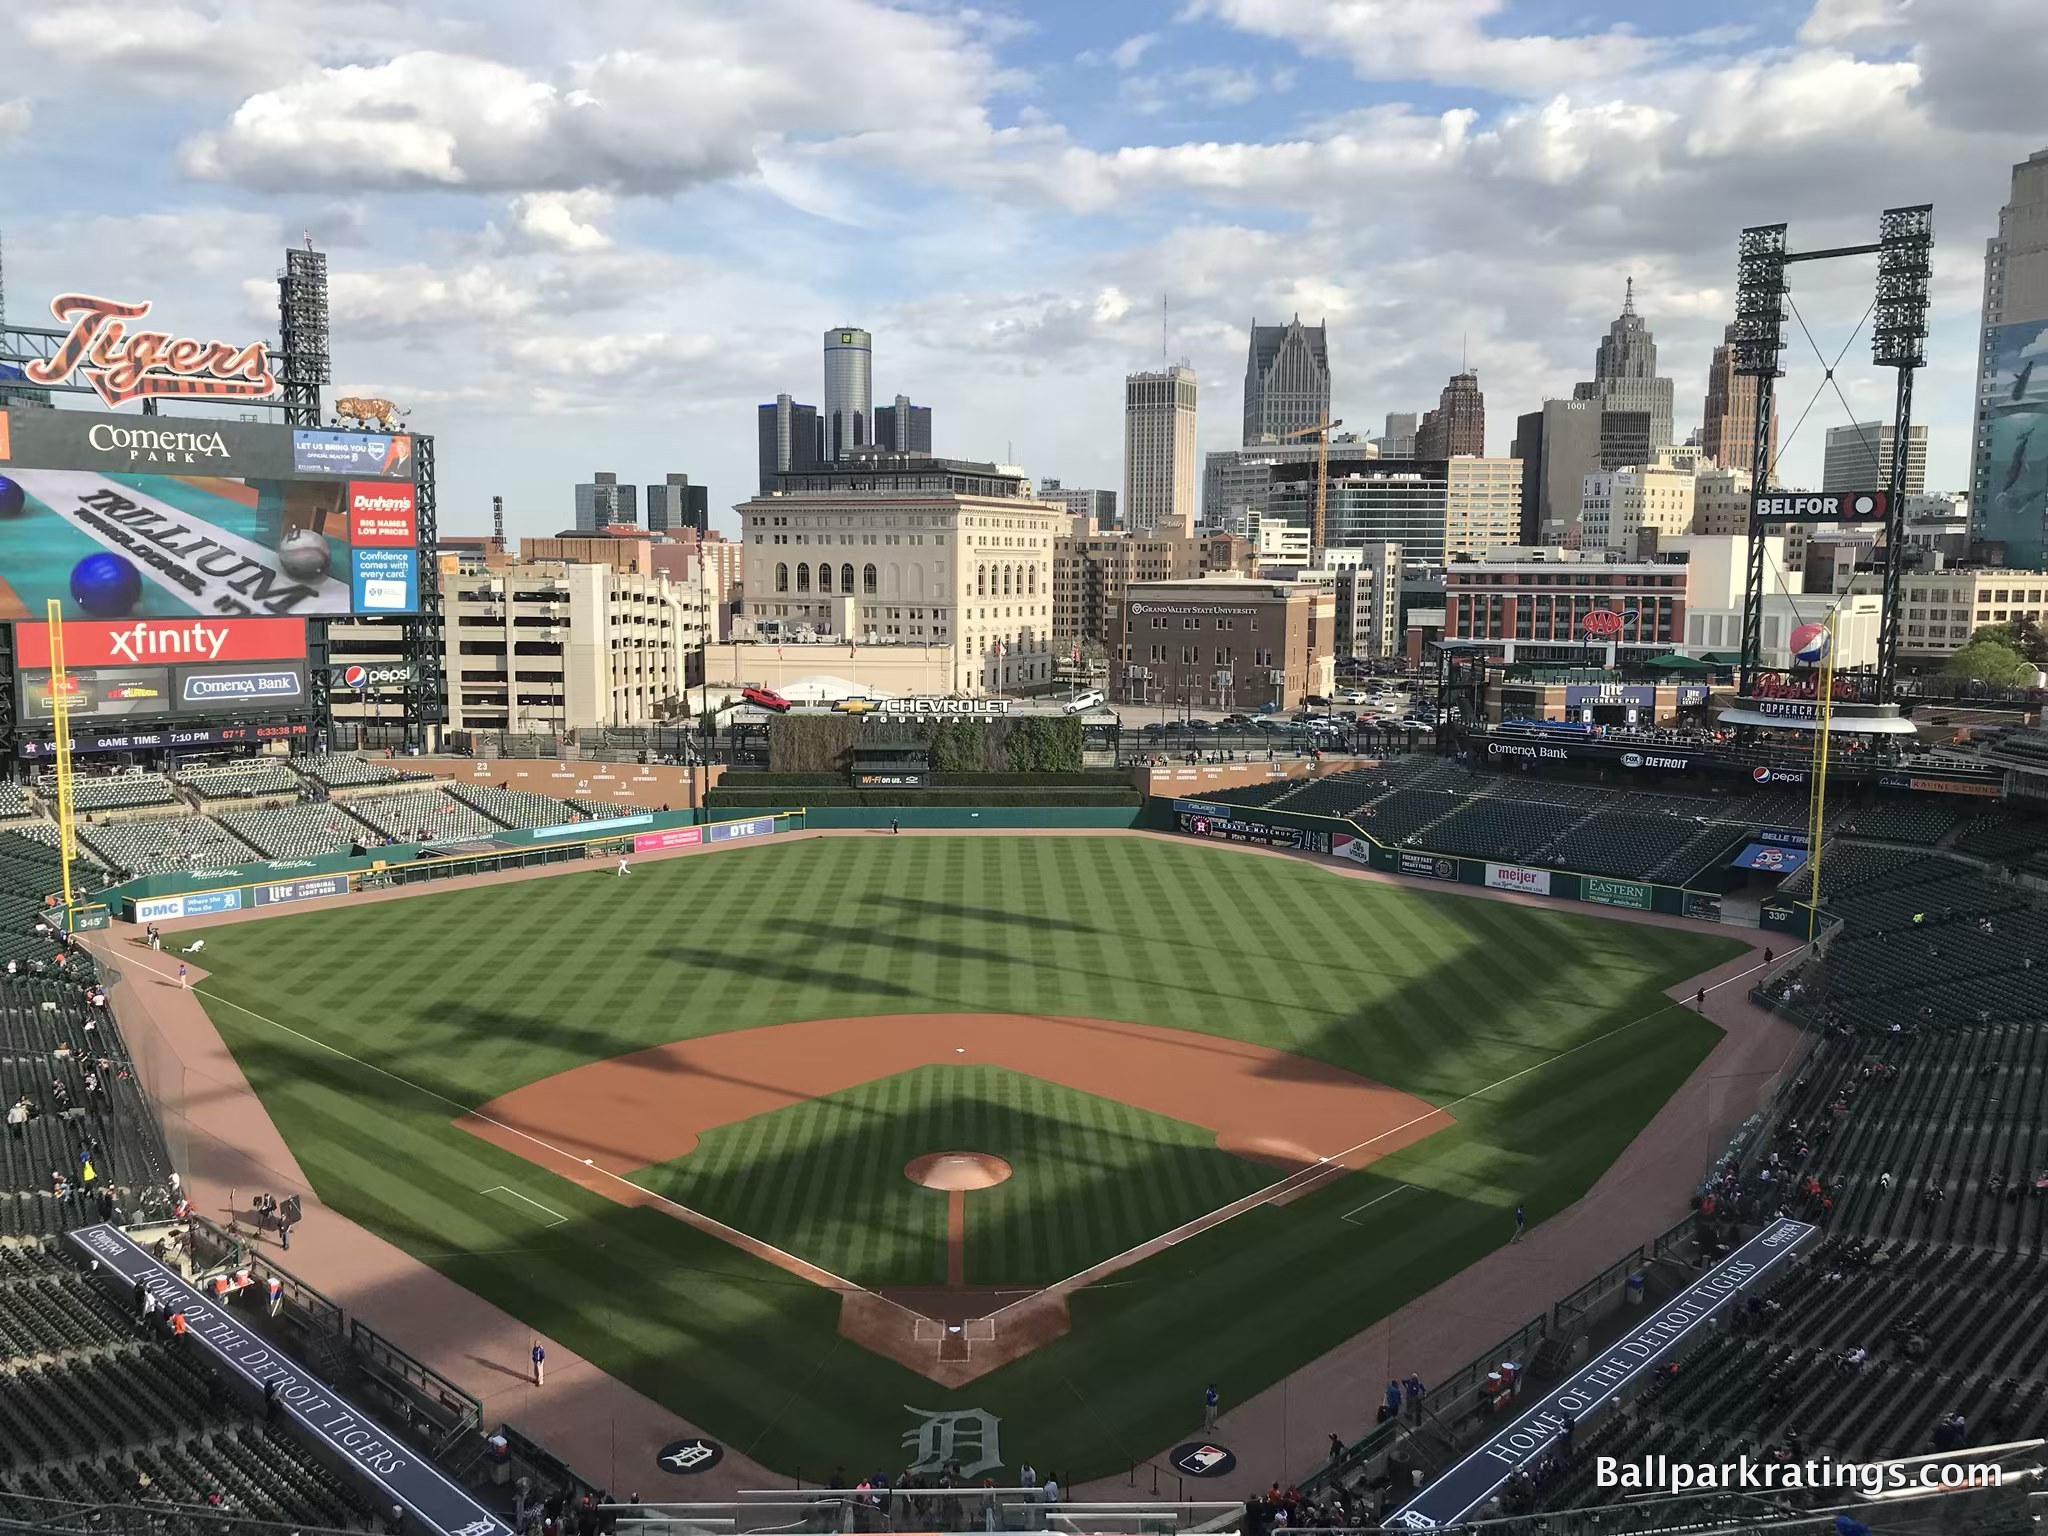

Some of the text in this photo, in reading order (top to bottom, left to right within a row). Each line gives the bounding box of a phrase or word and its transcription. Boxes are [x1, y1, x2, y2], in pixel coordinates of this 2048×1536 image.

[25, 293, 276, 408] Tigers
[296, 442, 311, 450] LET
[313, 443, 323, 451] US
[325, 444, 348, 452] BRING
[350, 445, 366, 453] YOU
[131, 450, 195, 463] PARK
[354, 495, 411, 509] Dunham's
[1756, 498, 1839, 515] BELFOR
[1165, 521, 1184, 529] Ashley
[379, 528, 409, 536] PRICES
[78, 488, 319, 613] TRILLIUM
[360, 551, 408, 561] Confidence
[390, 561, 408, 569] with
[360, 571, 384, 580] every
[1213, 606, 1258, 614] UNIVERSITY
[1585, 611, 1619, 633] AAA
[109, 622, 230, 661] xfinity
[368, 667, 411, 685] pepsi
[258, 676, 291, 691] Bank
[1600, 683, 1624, 697] Lite
[886, 699, 1013, 713] CHEVROLET
[862, 716, 994, 724] FOUNTAIN
[257, 725, 306, 737] 6:33:38 PM
[98, 738, 128, 747] GAME
[133, 736, 161, 745] TIME:
[170, 733, 191, 743] 7:10
[194, 732, 209, 741] PM
[1540, 747, 1568, 760] Bank
[477, 762, 488, 771] 23
[560, 763, 566, 771] 5
[1273, 763, 1281, 771] 11
[1305, 763, 1316, 771] 42
[1625, 755, 1688, 769] FOX DETROIT
[601, 765, 607, 773] 2
[641, 767, 649, 775] 16
[683, 769, 689, 777] 6
[862, 776, 881, 784] Wi-Fi
[1772, 772, 1803, 783] pepsi
[578, 780, 588, 788] 47
[621, 782, 627, 790] 3
[730, 823, 755, 837] DTE
[421, 834, 494, 847] MotorCityCasino.com
[1762, 832, 1790, 842] BELLE
[1498, 869, 1537, 884] meijer
[268, 886, 293, 902] Lite
[299, 888, 317, 896] LIGHT
[319, 886, 336, 895] BEER
[1589, 879, 1643, 897] EASTERN
[187, 898, 208, 906] Where
[141, 903, 178, 917] DMC
[80, 916, 103, 928] 345'
[1486, 1260, 1757, 1465] HOME OF THE DETROIT TIGERS
[133, 1267, 406, 1475] HOME OF THE DETROIT TIGERS
